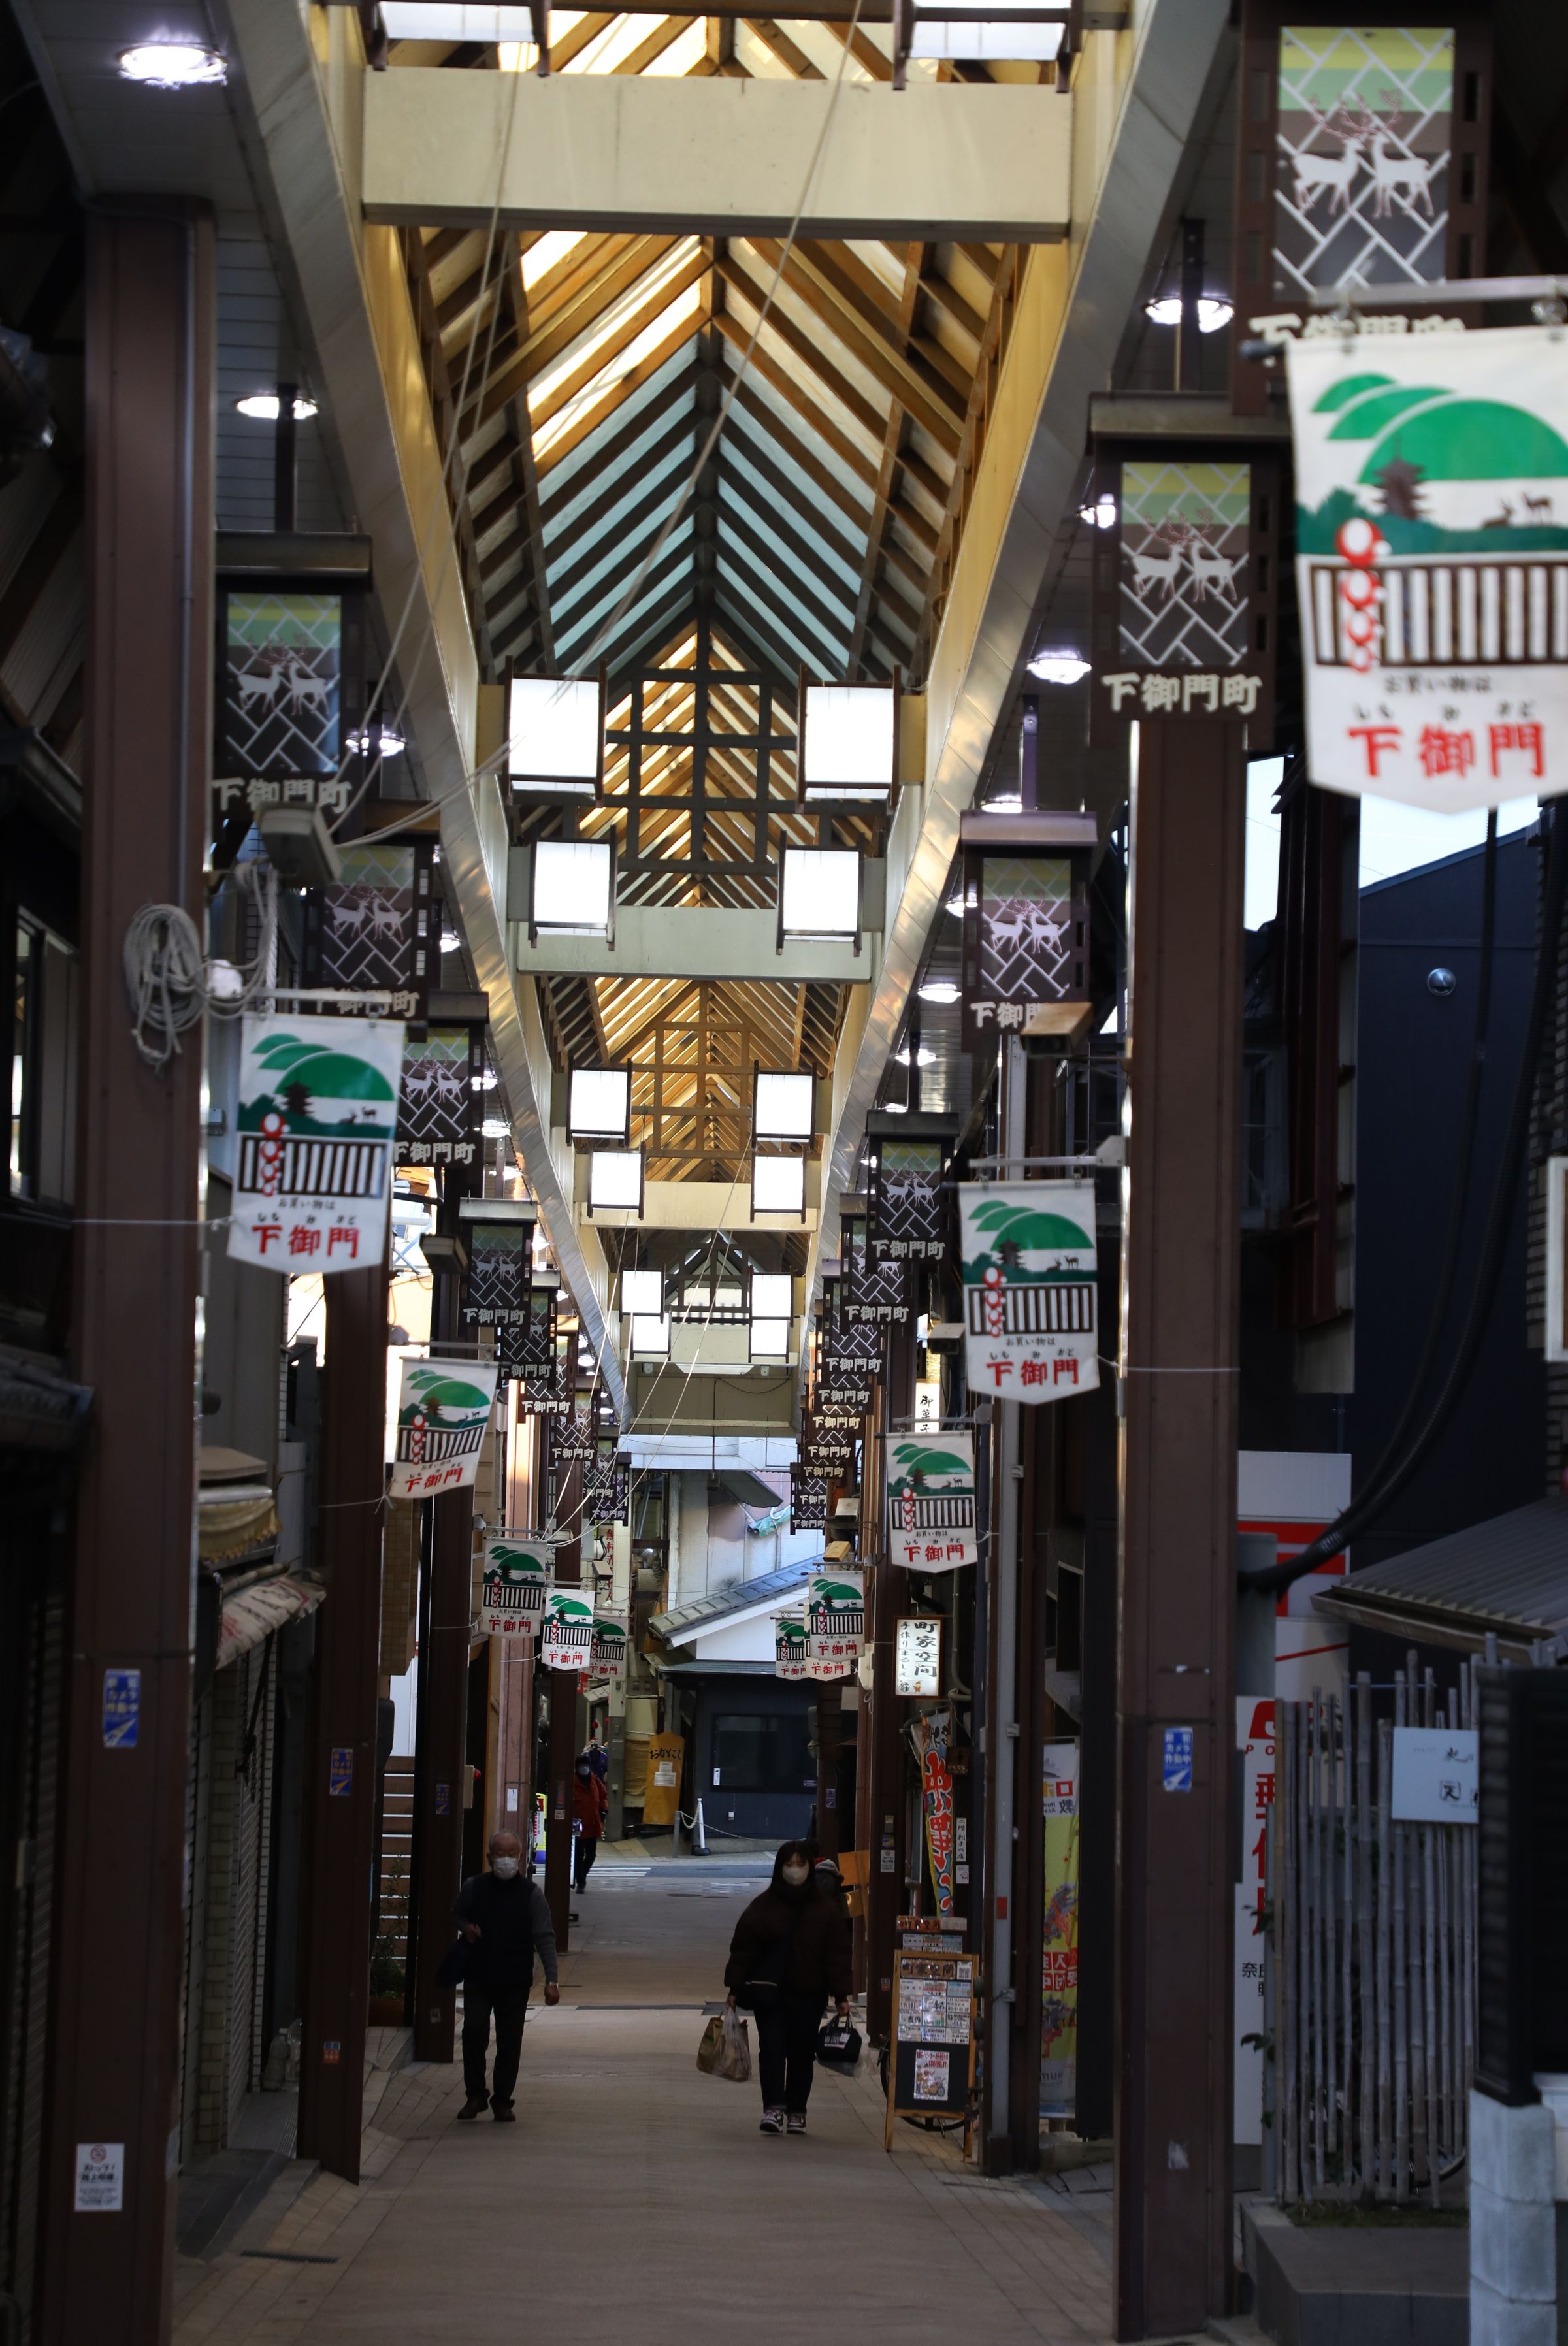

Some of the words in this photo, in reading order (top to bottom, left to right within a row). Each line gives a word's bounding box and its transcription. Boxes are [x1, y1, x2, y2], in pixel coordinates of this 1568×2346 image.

[1102, 672, 1262, 715] 下御門町
[1348, 721, 1546, 779] 下御門
[252, 1224, 360, 1259] 下御門
[872, 1239, 945, 1260] 下御門町
[463, 1307, 525, 1326] 下御門町
[844, 1305, 909, 1322] 下御門町
[1006, 1336, 1056, 1346] お買い物は
[826, 1357, 882, 1373] 下御門町
[987, 1358, 1079, 1386] 下御門
[818, 1390, 870, 1403] 下御門町
[522, 1401, 571, 1414] 下御門町
[812, 1416, 861, 1429] 下御門町
[552, 1448, 595, 1459] 下御門町
[808, 1446, 852, 1458] 下御門町
[405, 1467, 463, 1492] 下御門
[804, 1467, 844, 1478] 下御門町
[904, 1544, 964, 1563] 下御門
[489, 1619, 531, 1634] 下御門
[818, 1644, 857, 1656] 下御門
[915, 1621, 939, 1678] 町家空間
[549, 1653, 583, 1665] 下御門
[589, 1666, 617, 1676] 下御門
[811, 1665, 844, 1675] 下御門
